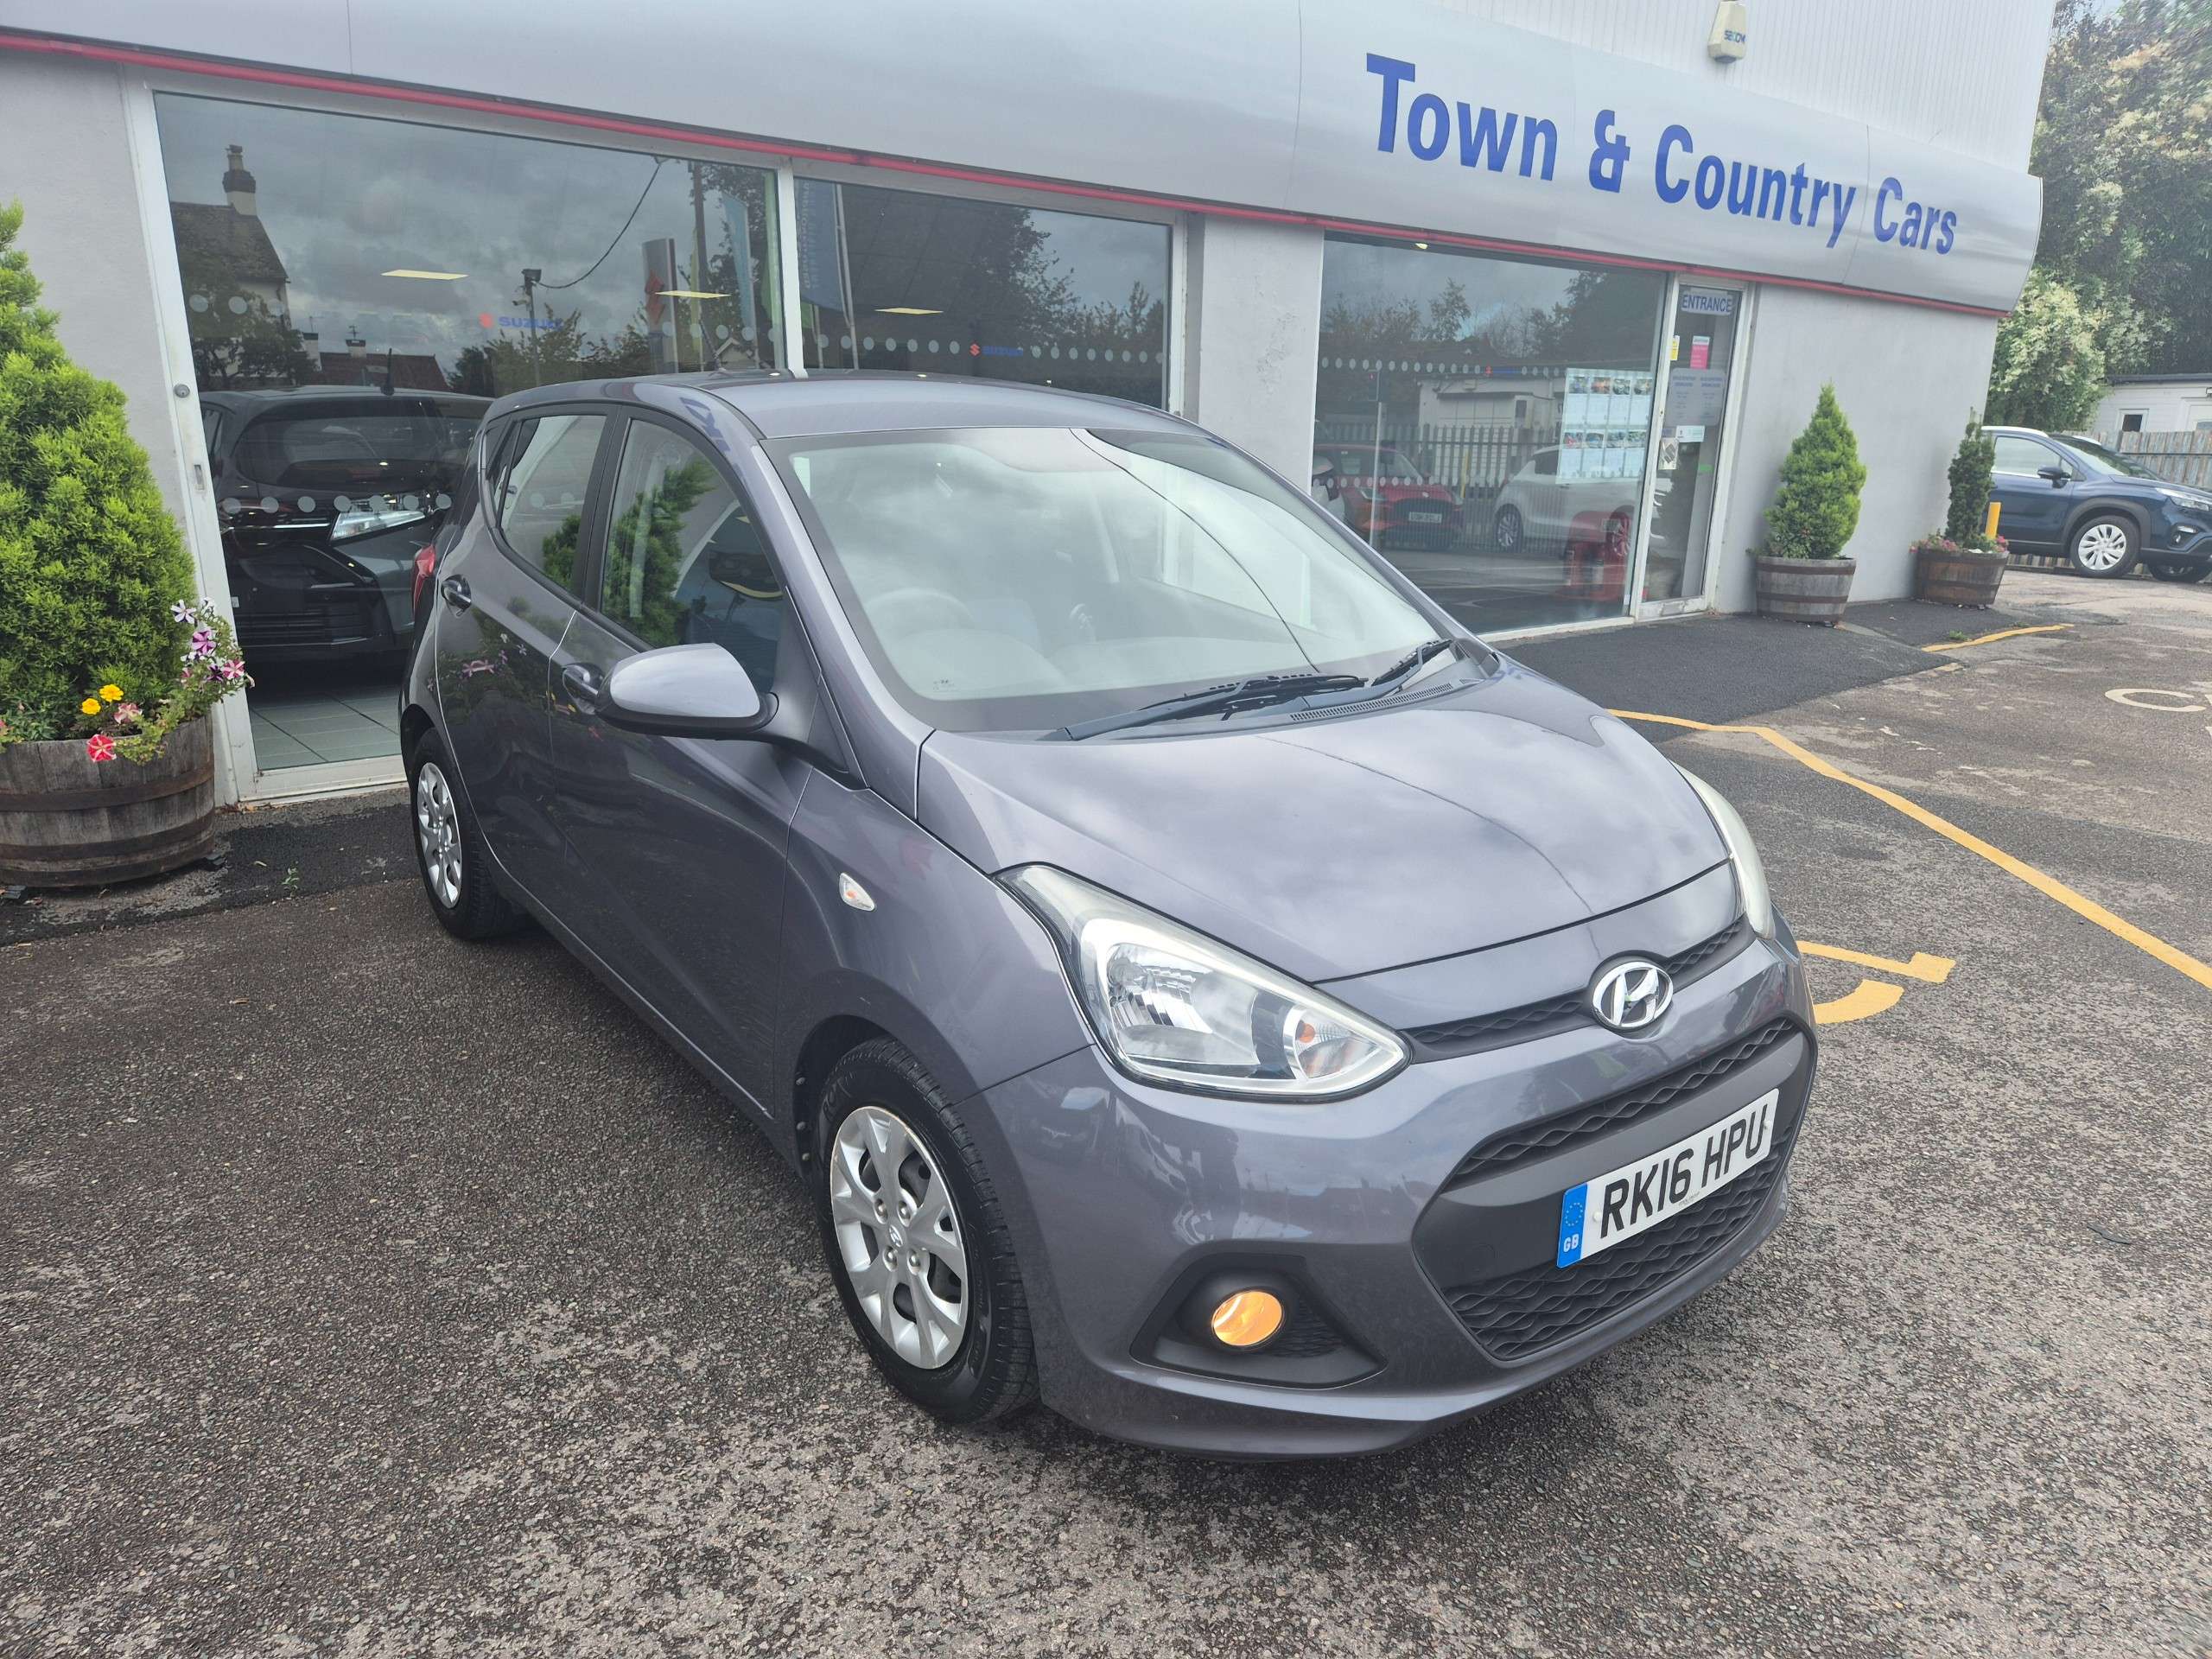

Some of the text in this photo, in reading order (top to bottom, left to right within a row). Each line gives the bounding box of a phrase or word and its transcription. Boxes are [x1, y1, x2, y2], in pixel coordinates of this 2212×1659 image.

[1366, 53, 1957, 255] Town & Country Cars
[1682, 294, 1732, 312] ENTRANCE
[1600, 1103, 1769, 1239] RK16 HPU
[1563, 1233, 1580, 1253] GB
